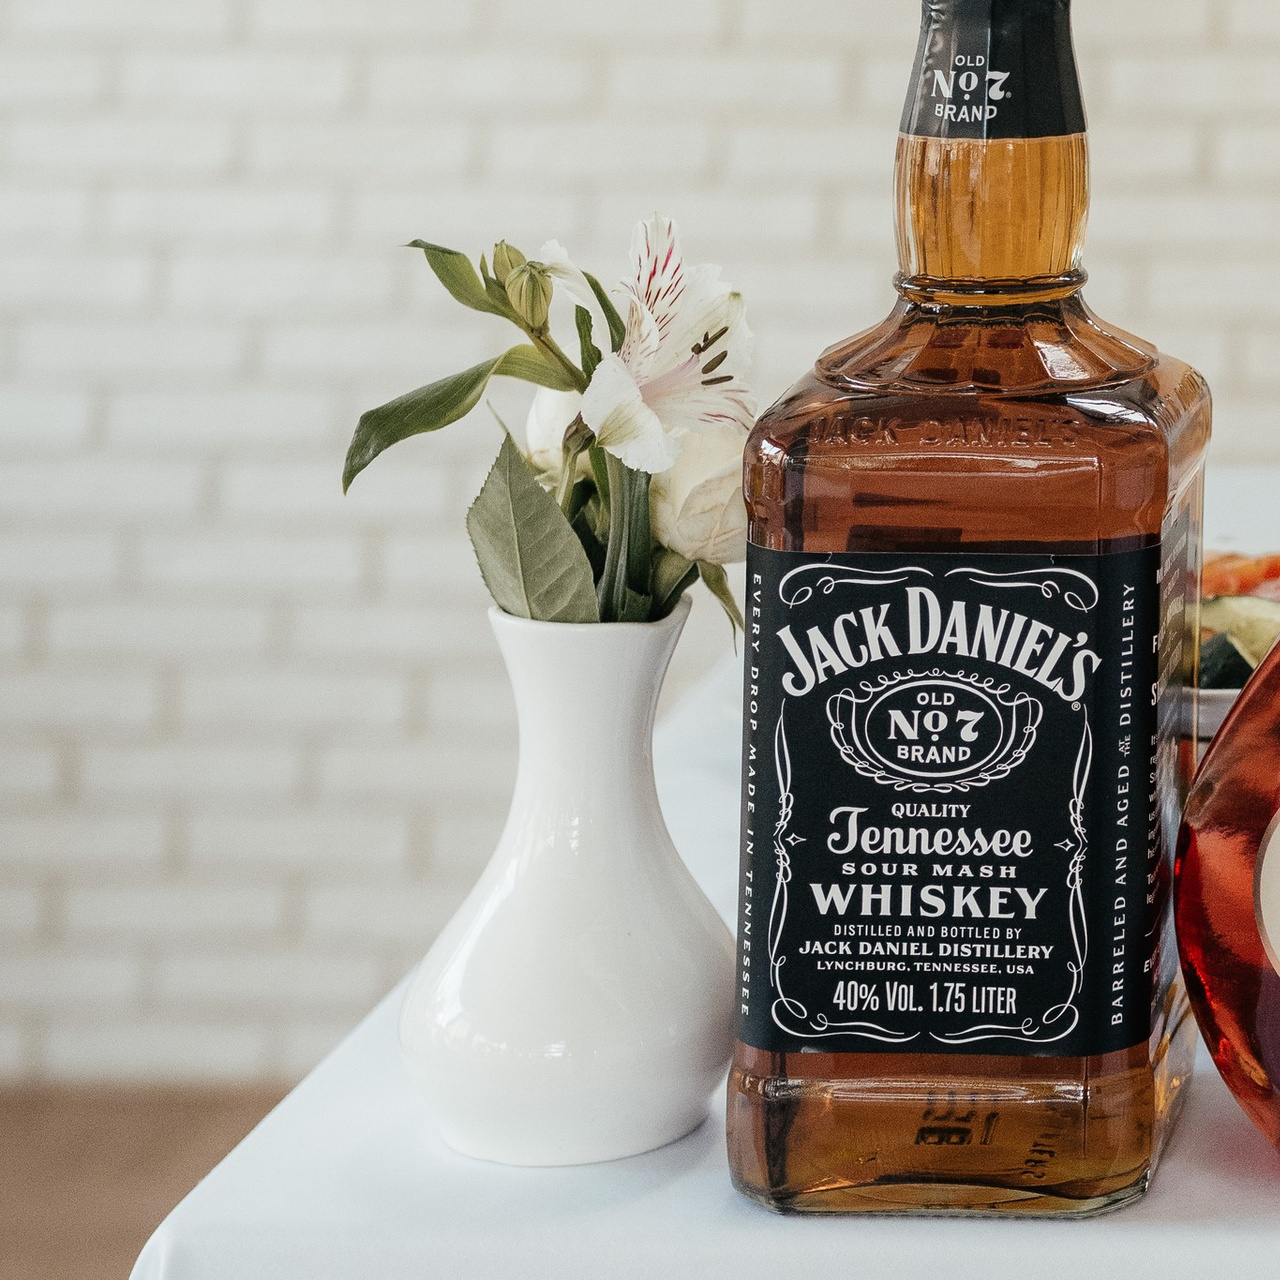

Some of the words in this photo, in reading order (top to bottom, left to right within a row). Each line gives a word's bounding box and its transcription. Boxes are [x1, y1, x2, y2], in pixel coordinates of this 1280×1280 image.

[955, 55, 985, 66] OLD
[934, 103, 997, 122] BRAND
[751, 573, 762, 653] EVERY
[775, 601, 901, 698] JACK
[904, 586, 1102, 702] DANIEL'S
[1120, 584, 1135, 726] DISTILLERY
[749, 665, 759, 731] DROP
[916, 692, 955, 706] OLD
[897, 745, 971, 764] BRAND
[747, 744, 757, 814] MADE
[1117, 764, 1130, 827] AGED
[891, 802, 972, 819] QUALITY
[746, 828, 754, 855] IN
[826, 804, 1034, 858] Tennessee
[841, 862, 919, 876] SOUR
[932, 863, 1017, 879] MASH
[1114, 838, 1127, 886] AND
[809, 883, 1049, 920] WHISKEY
[741, 870, 753, 1016] TENNESSEE
[798, 940, 853, 955] JACK
[858, 941, 934, 956] DANIEL
[938, 943, 1054, 959] DISTILLERY
[833, 924, 902, 937] DISTILLED
[906, 925, 935, 938] AND
[940, 926, 1000, 939] BOTTLED
[1005, 927, 1022, 940] BY
[1006, 964, 1034, 975] USA
[1111, 896, 1126, 1026] BARRELED
[832, 980, 880, 1011] 40%
[885, 981, 924, 1012] VOL.
[929, 982, 966, 1013] 1.75
[972, 986, 1017, 1015] LITER
